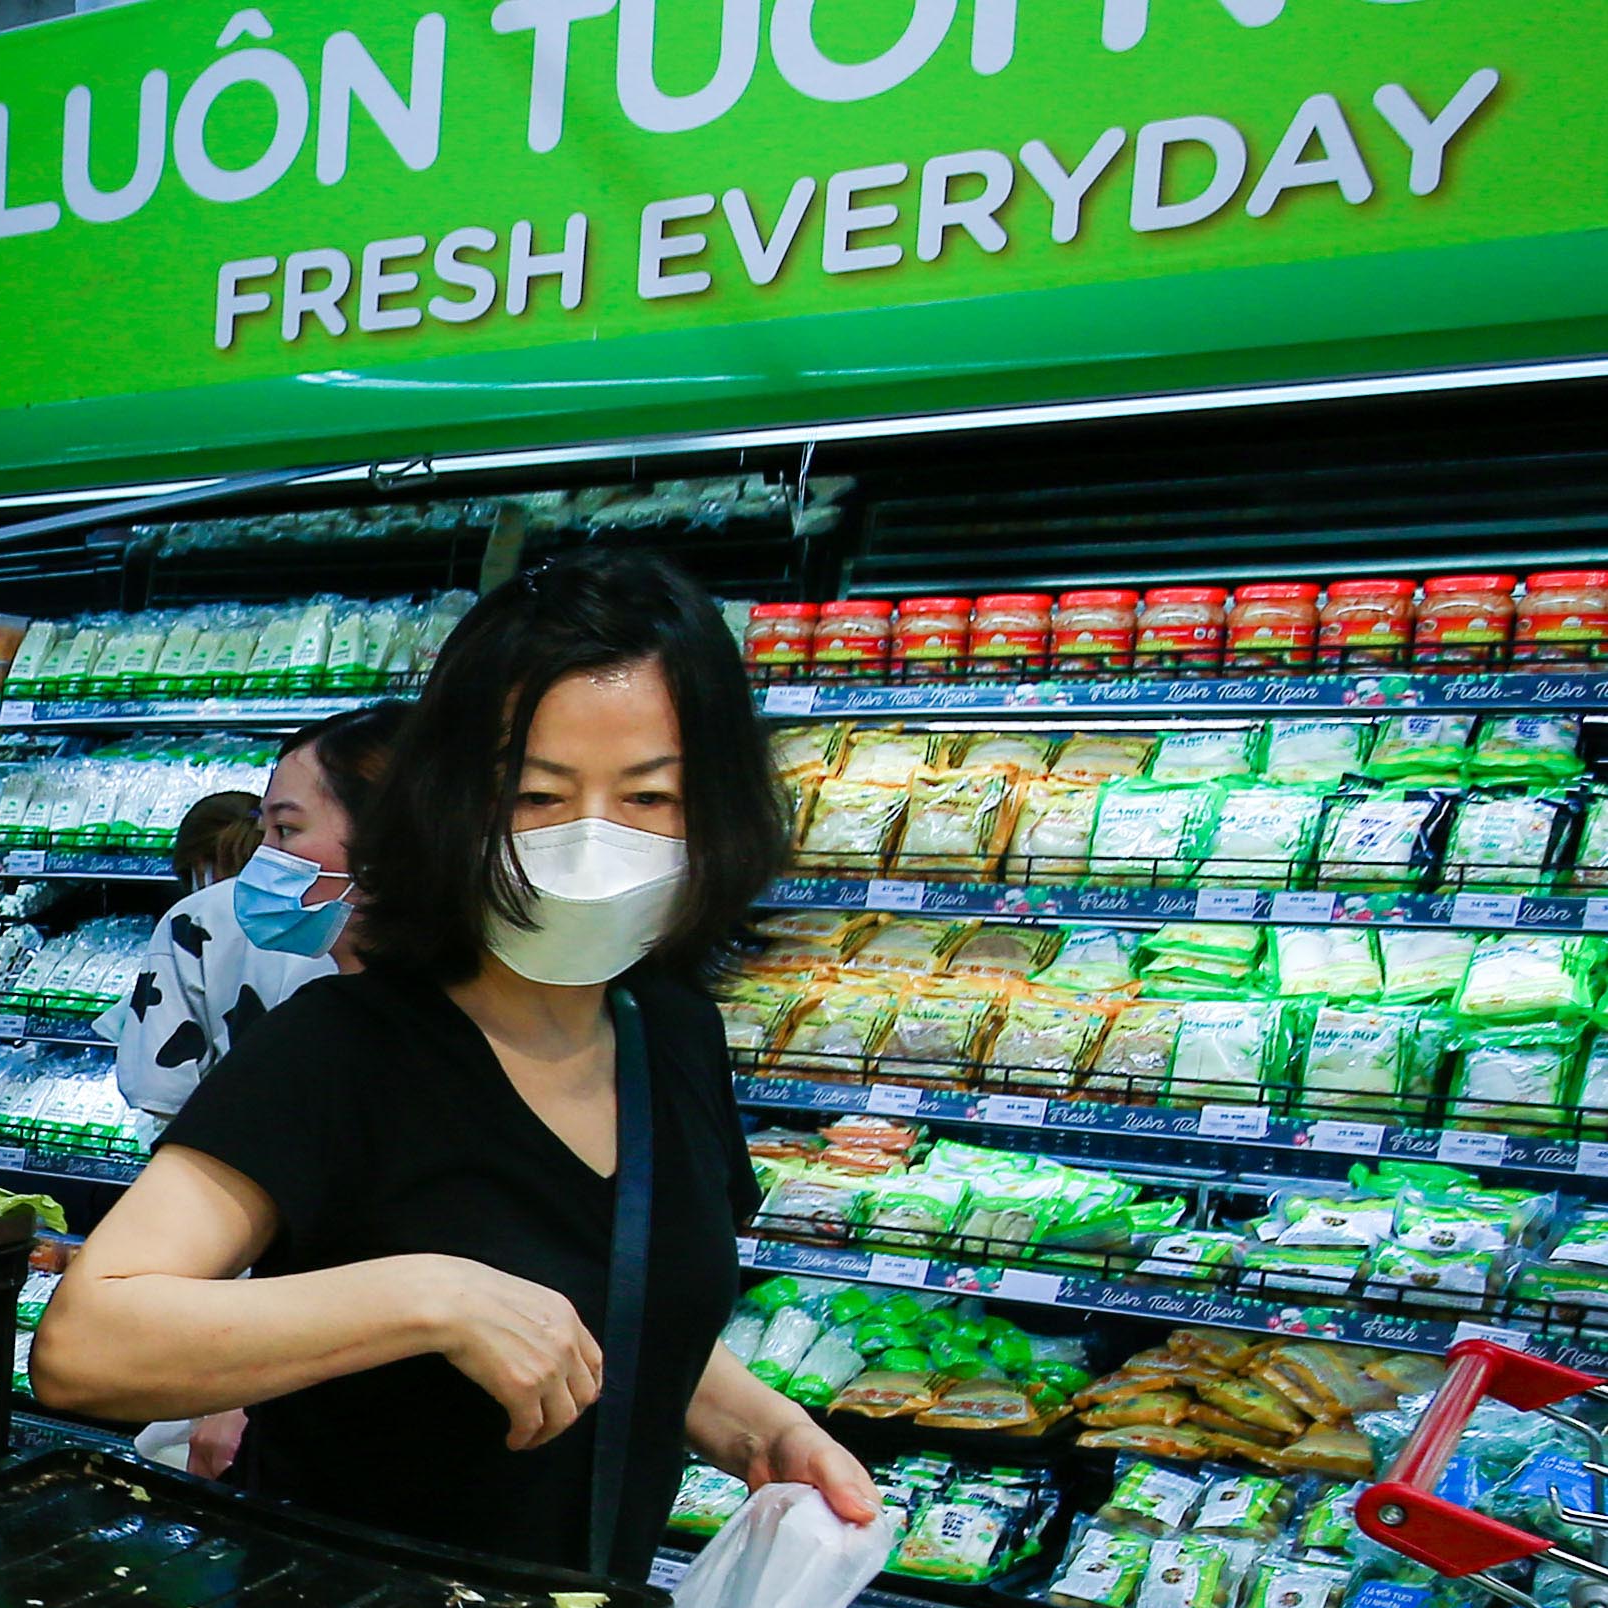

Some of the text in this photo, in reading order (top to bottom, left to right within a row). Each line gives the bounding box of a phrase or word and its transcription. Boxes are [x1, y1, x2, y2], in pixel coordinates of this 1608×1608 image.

[215, 68, 1499, 349] FRESH EVERYDAY
[1088, 681, 1141, 702] Fresh
[1260, 680, 1320, 705] Ngon
[1441, 680, 1504, 702] Fresh
[1530, 679, 1587, 703] Luôn
[1077, 893, 1130, 912] Fresh
[1516, 904, 1572, 924] Luôn
[1048, 1106, 1098, 1126] Fresh
[1097, 1287, 1142, 1309] Luôn
[1189, 1298, 1245, 1321] Ngon
[1360, 1318, 1419, 1343] Fresh
